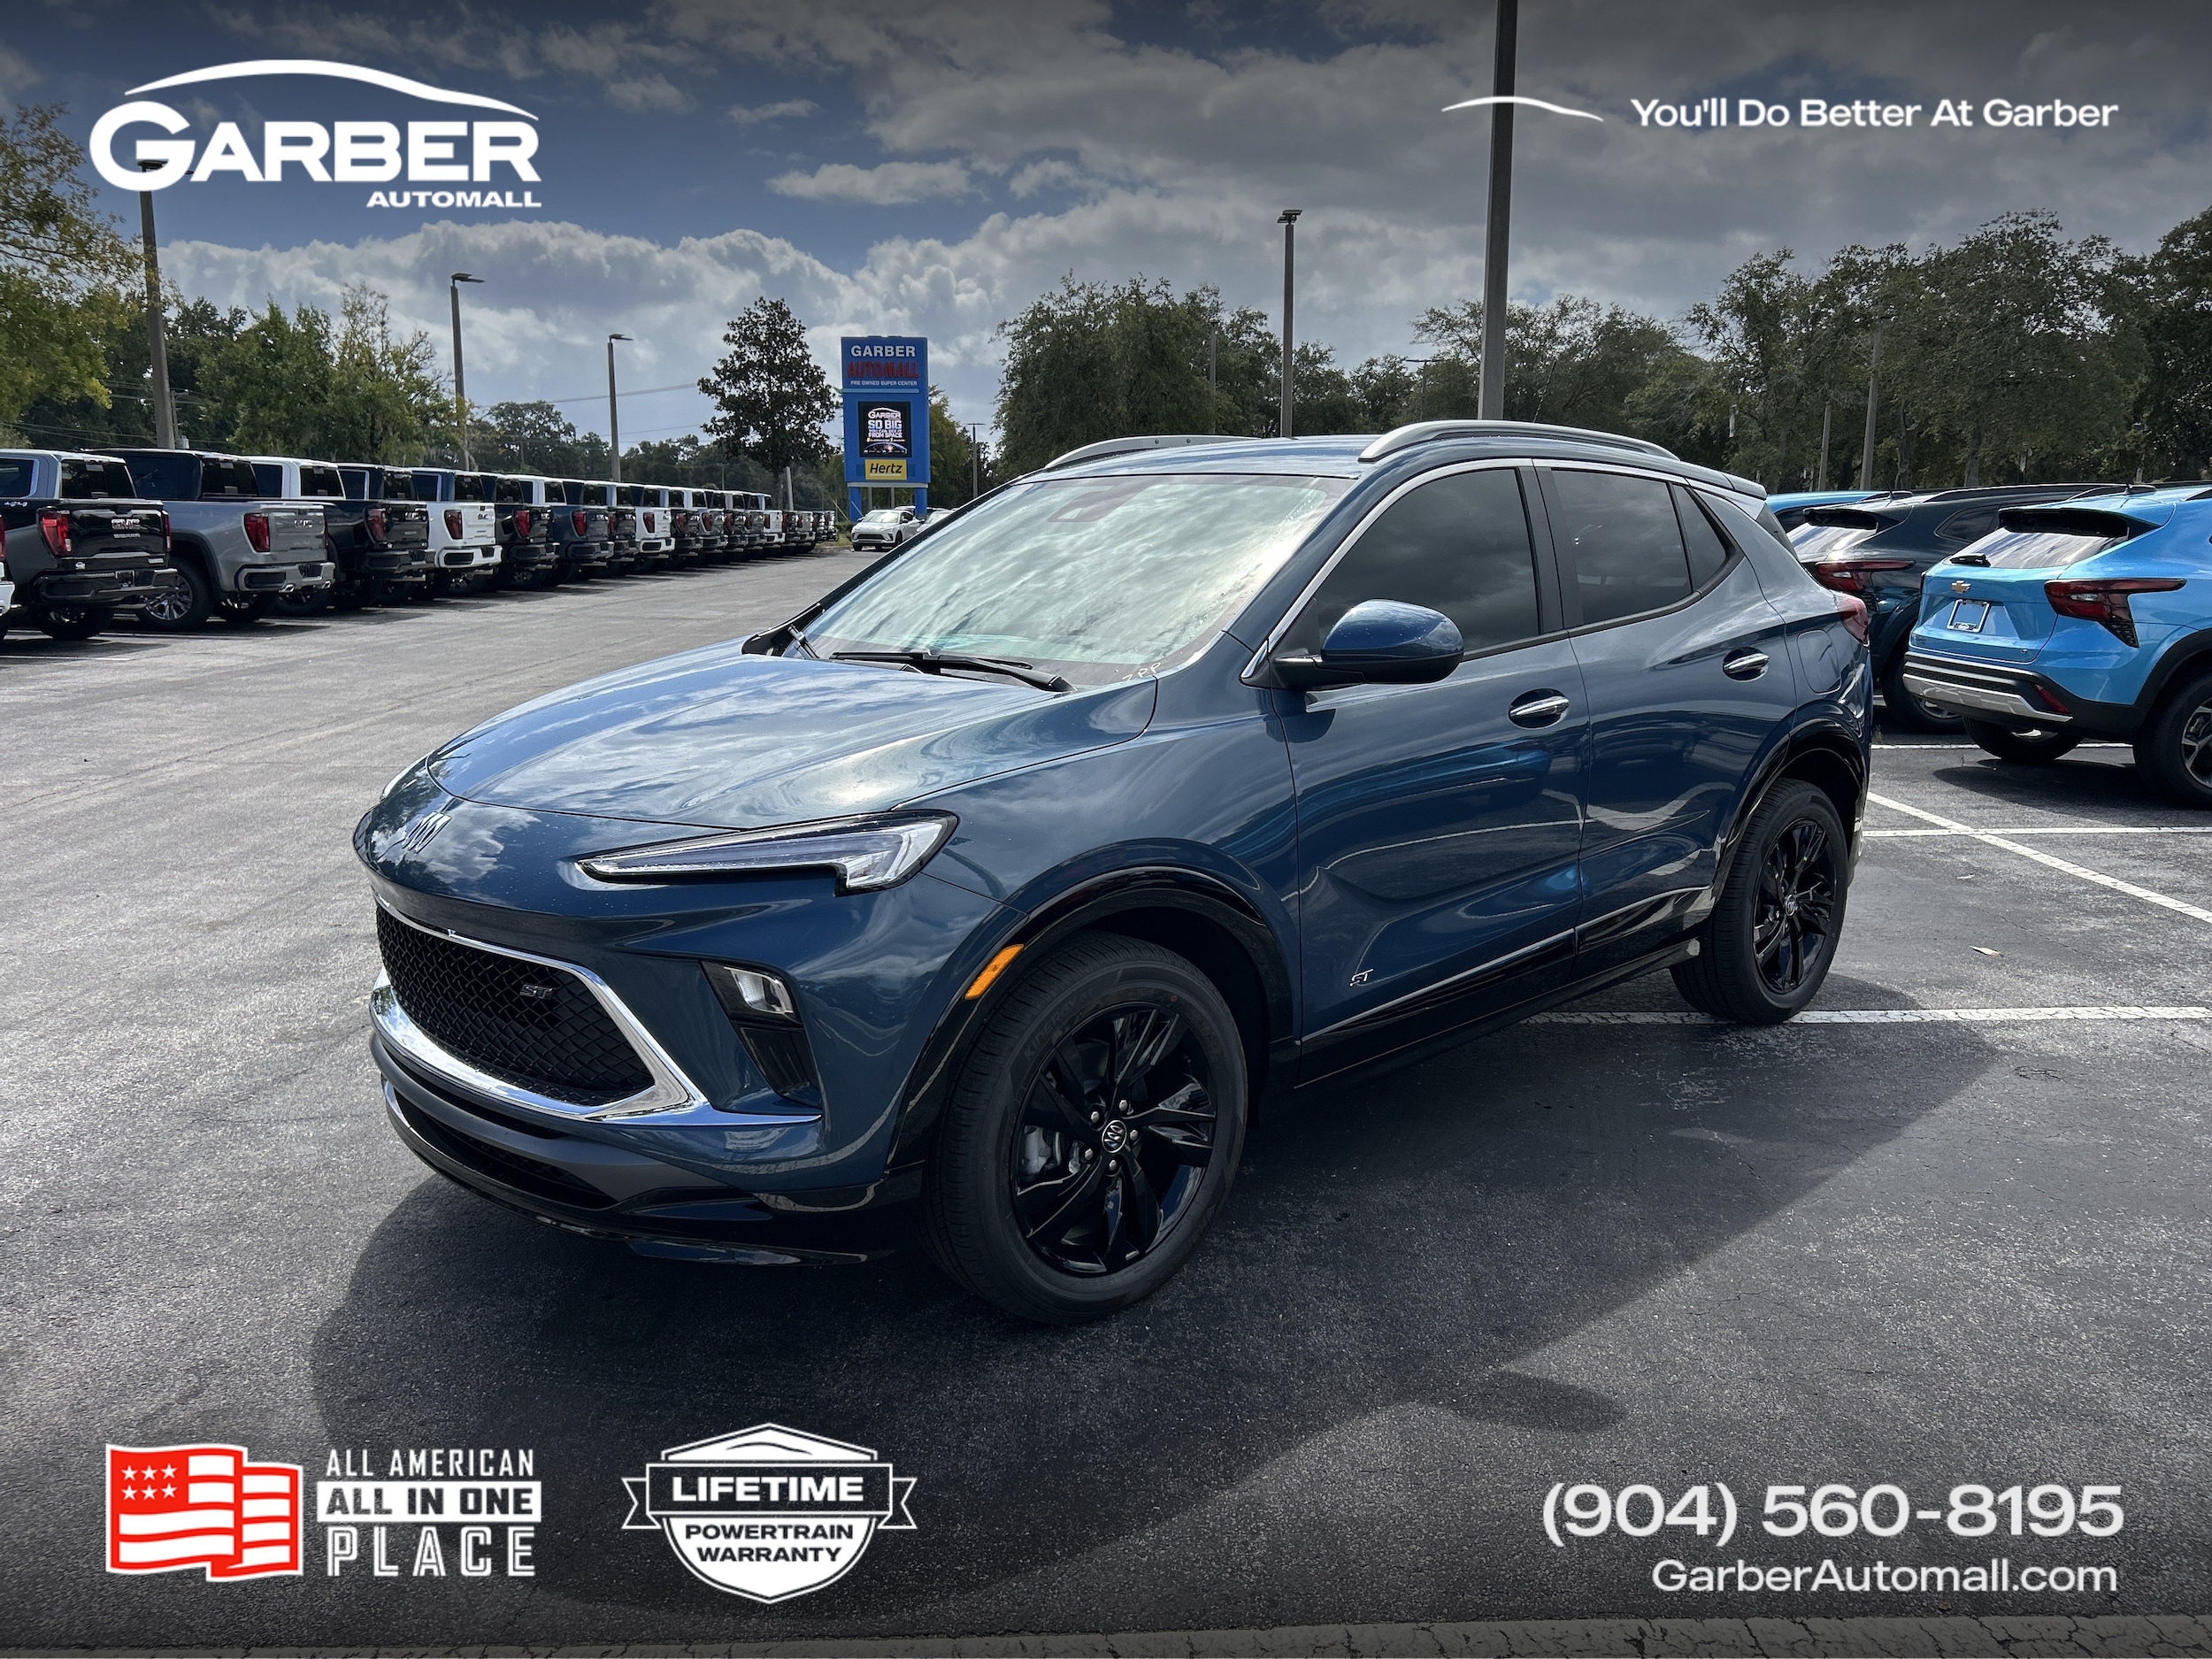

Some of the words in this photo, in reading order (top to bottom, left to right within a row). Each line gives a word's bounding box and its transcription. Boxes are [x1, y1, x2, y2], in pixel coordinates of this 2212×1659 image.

[850, 345, 916, 357] GARBER
[847, 361, 920, 379] AUTOMALL
[868, 411, 901, 419] GARBER
[884, 419, 902, 430] BIG
[870, 463, 903, 474] Hertz
[519, 984, 553, 999] ST
[1024, 995, 1077, 1062] KINERGY
